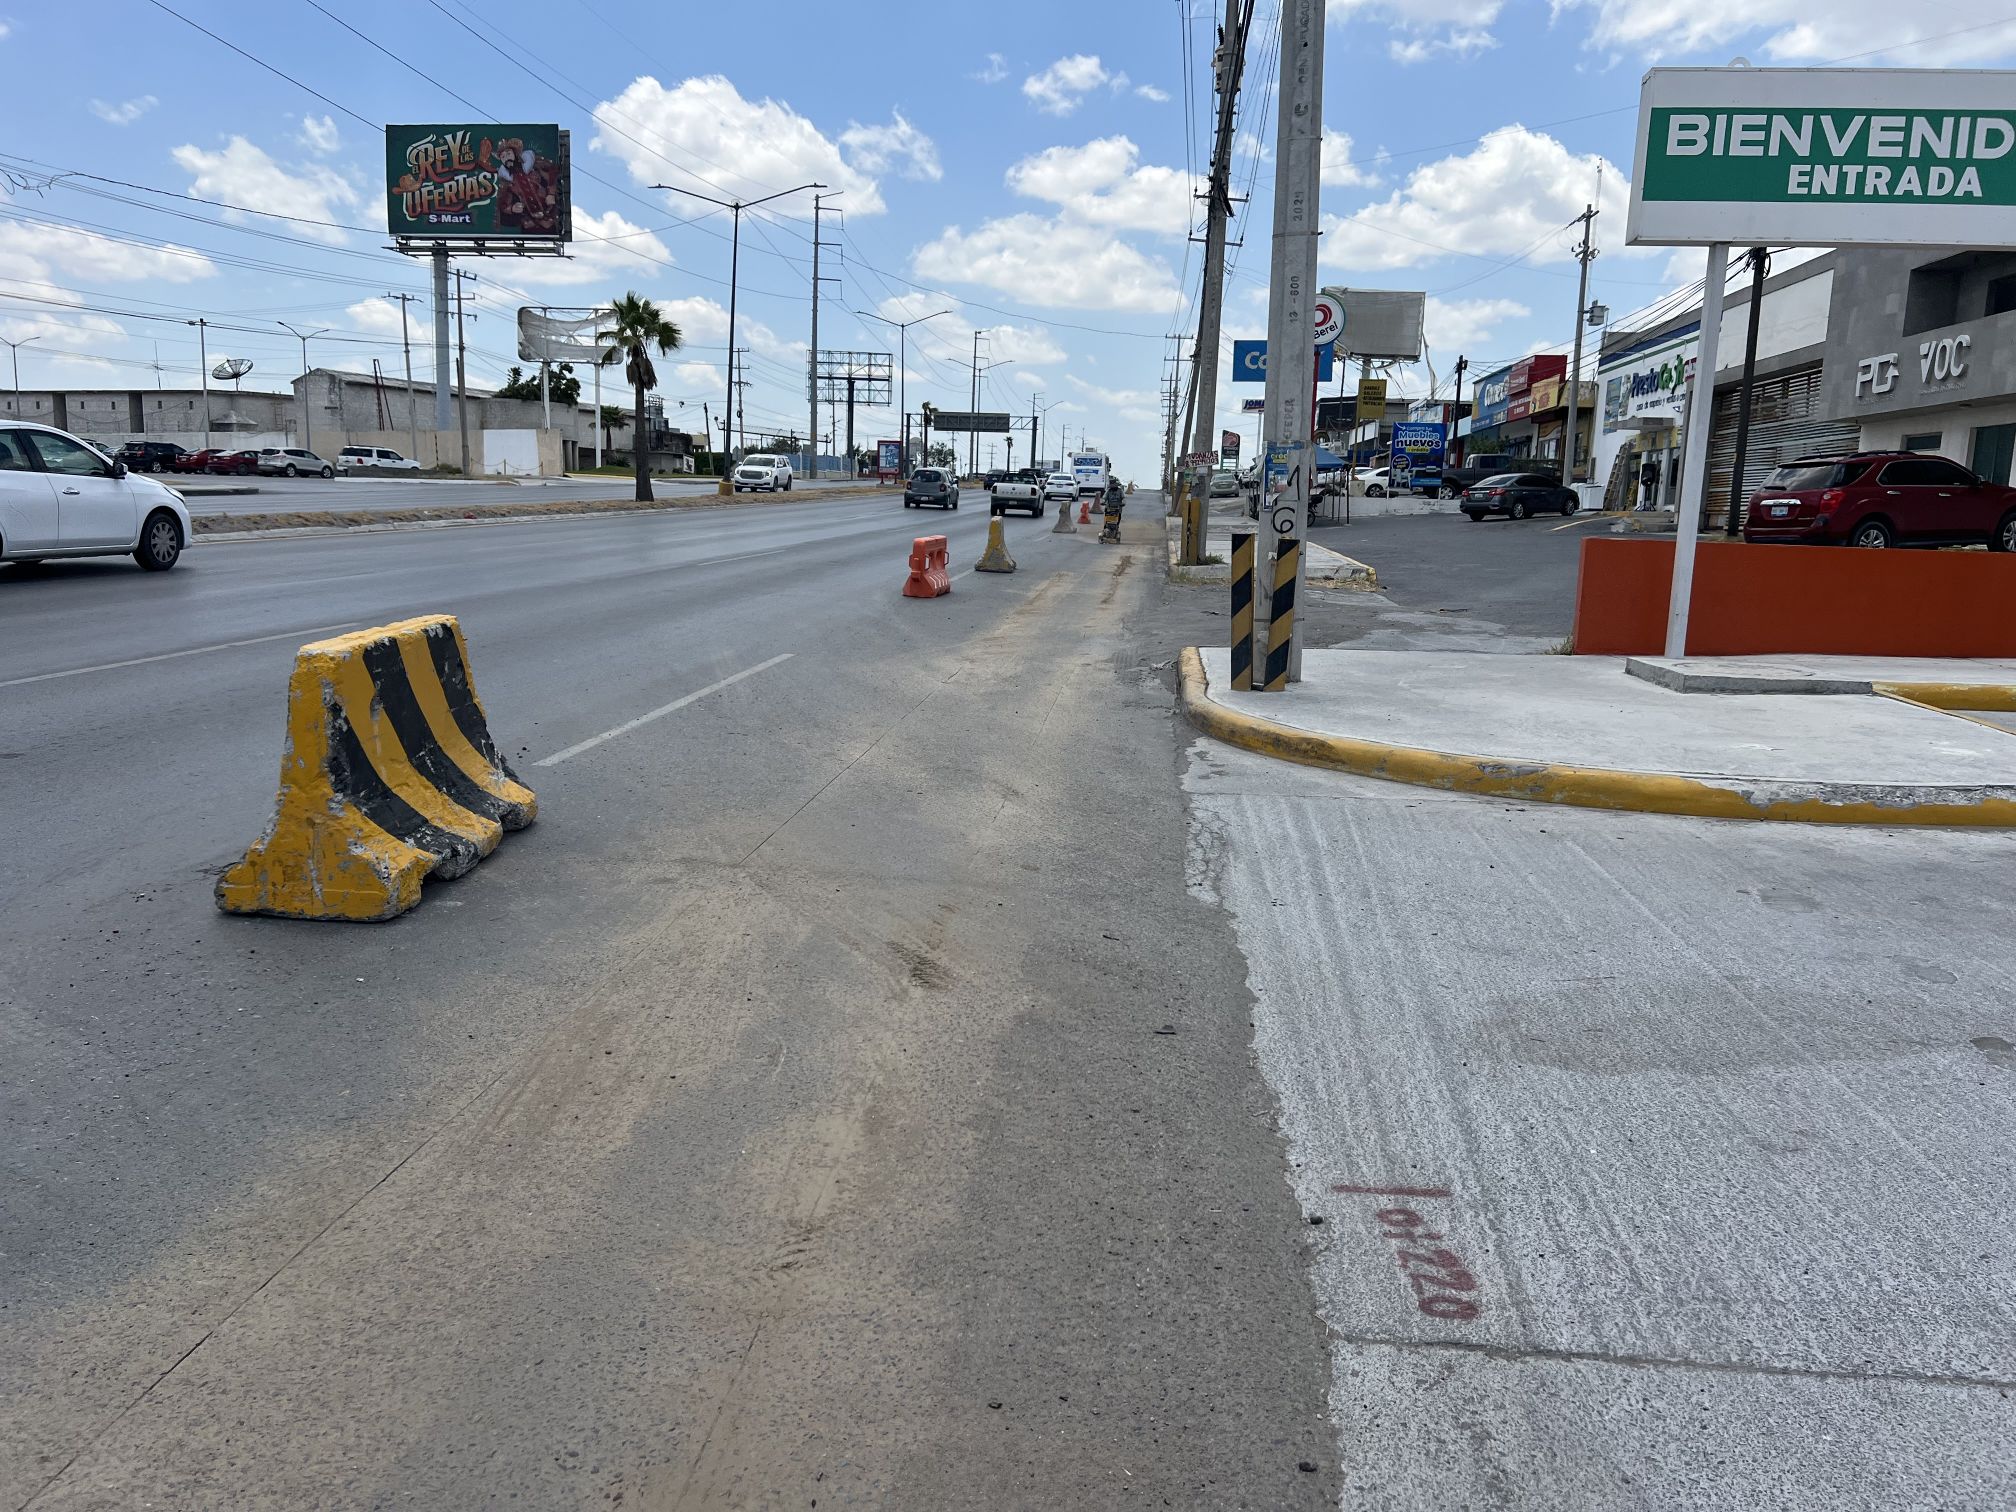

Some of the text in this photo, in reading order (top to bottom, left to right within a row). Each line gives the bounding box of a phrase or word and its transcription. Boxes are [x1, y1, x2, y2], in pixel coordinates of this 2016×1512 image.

[408, 130, 475, 183] REY
[1787, 164, 1983, 198] ENTRADA
[1920, 335, 1971, 383] VOC
[1395, 439, 1441, 449] nuevos
[1398, 430, 1440, 440] Muebles
